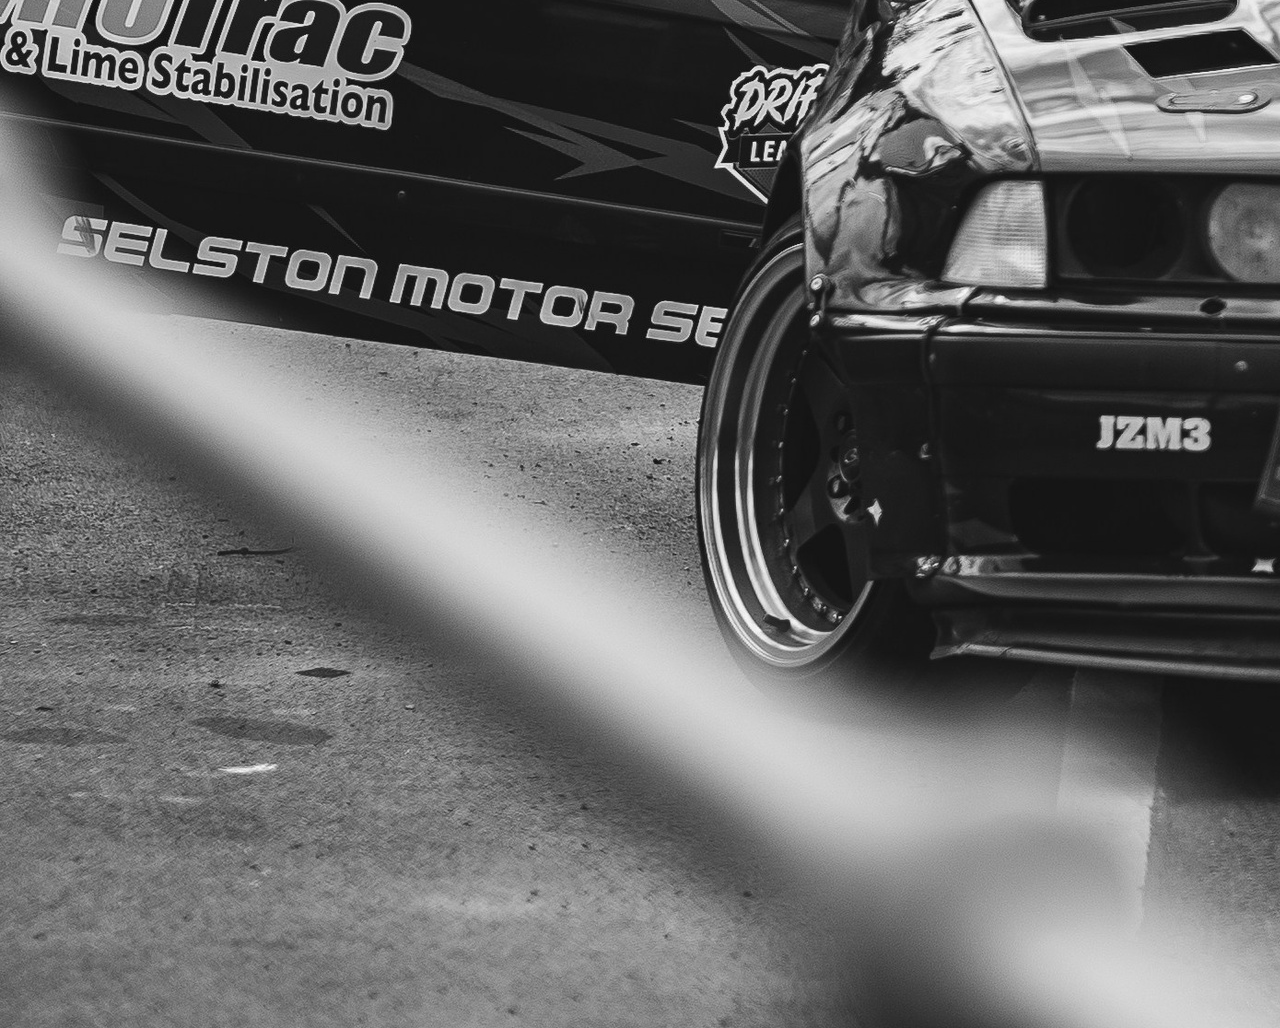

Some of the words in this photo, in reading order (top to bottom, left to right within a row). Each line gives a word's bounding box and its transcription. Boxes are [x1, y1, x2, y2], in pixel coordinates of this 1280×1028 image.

[5, 30, 34, 69] &
[47, 35, 139, 85] Lime
[151, 52, 388, 125] Stabilisation
[56, 214, 379, 300] SELSTON
[389, 262, 636, 335] MOTOR
[1095, 414, 1212, 452] JZM3
